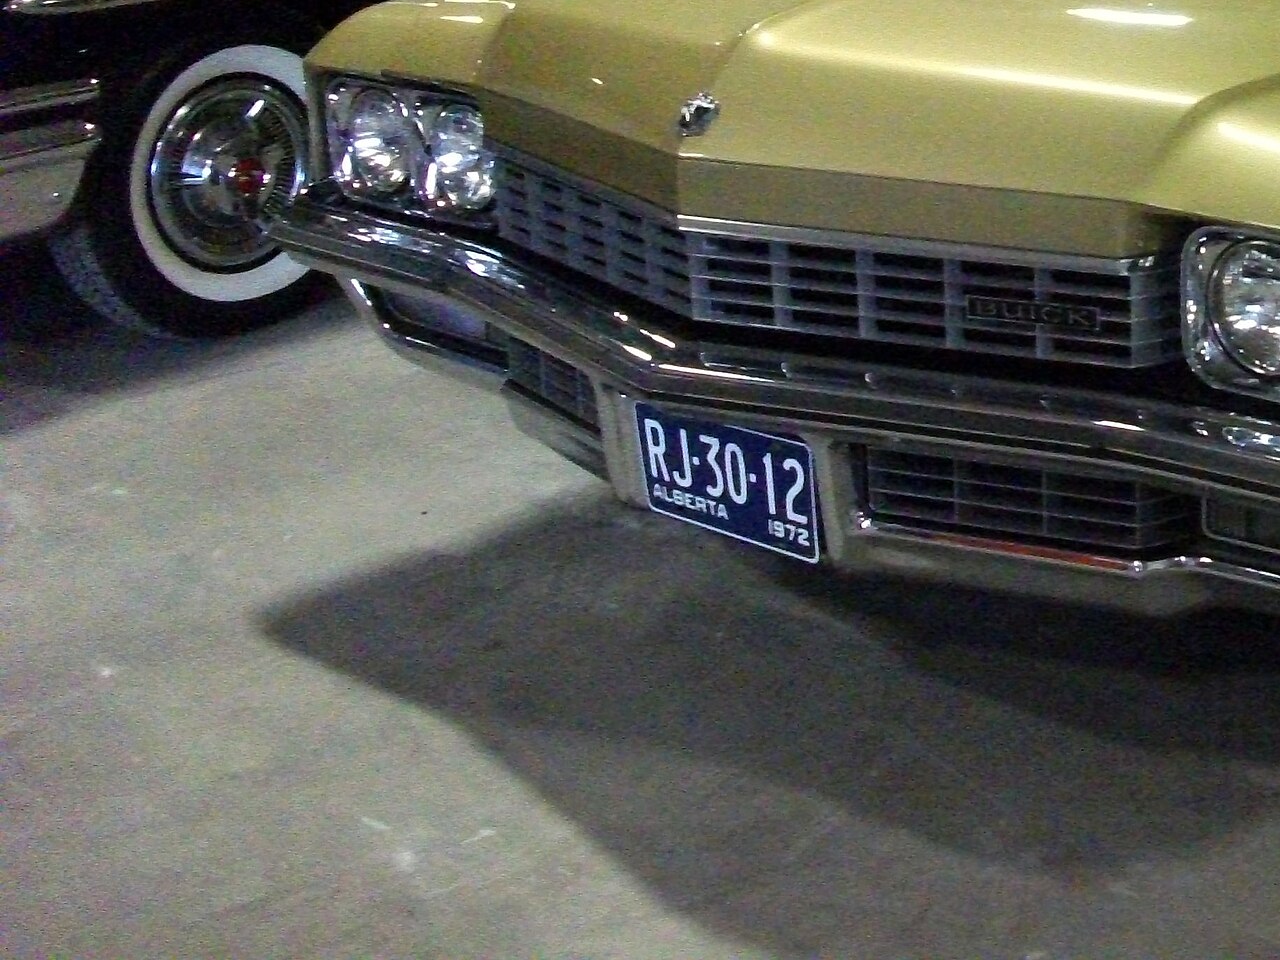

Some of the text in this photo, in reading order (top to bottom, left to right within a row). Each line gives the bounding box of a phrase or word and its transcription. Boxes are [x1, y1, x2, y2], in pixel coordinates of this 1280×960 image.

[976, 300, 1091, 329] BUICK
[652, 483, 729, 520] ALBERTA
[767, 519, 810, 546] 1972
